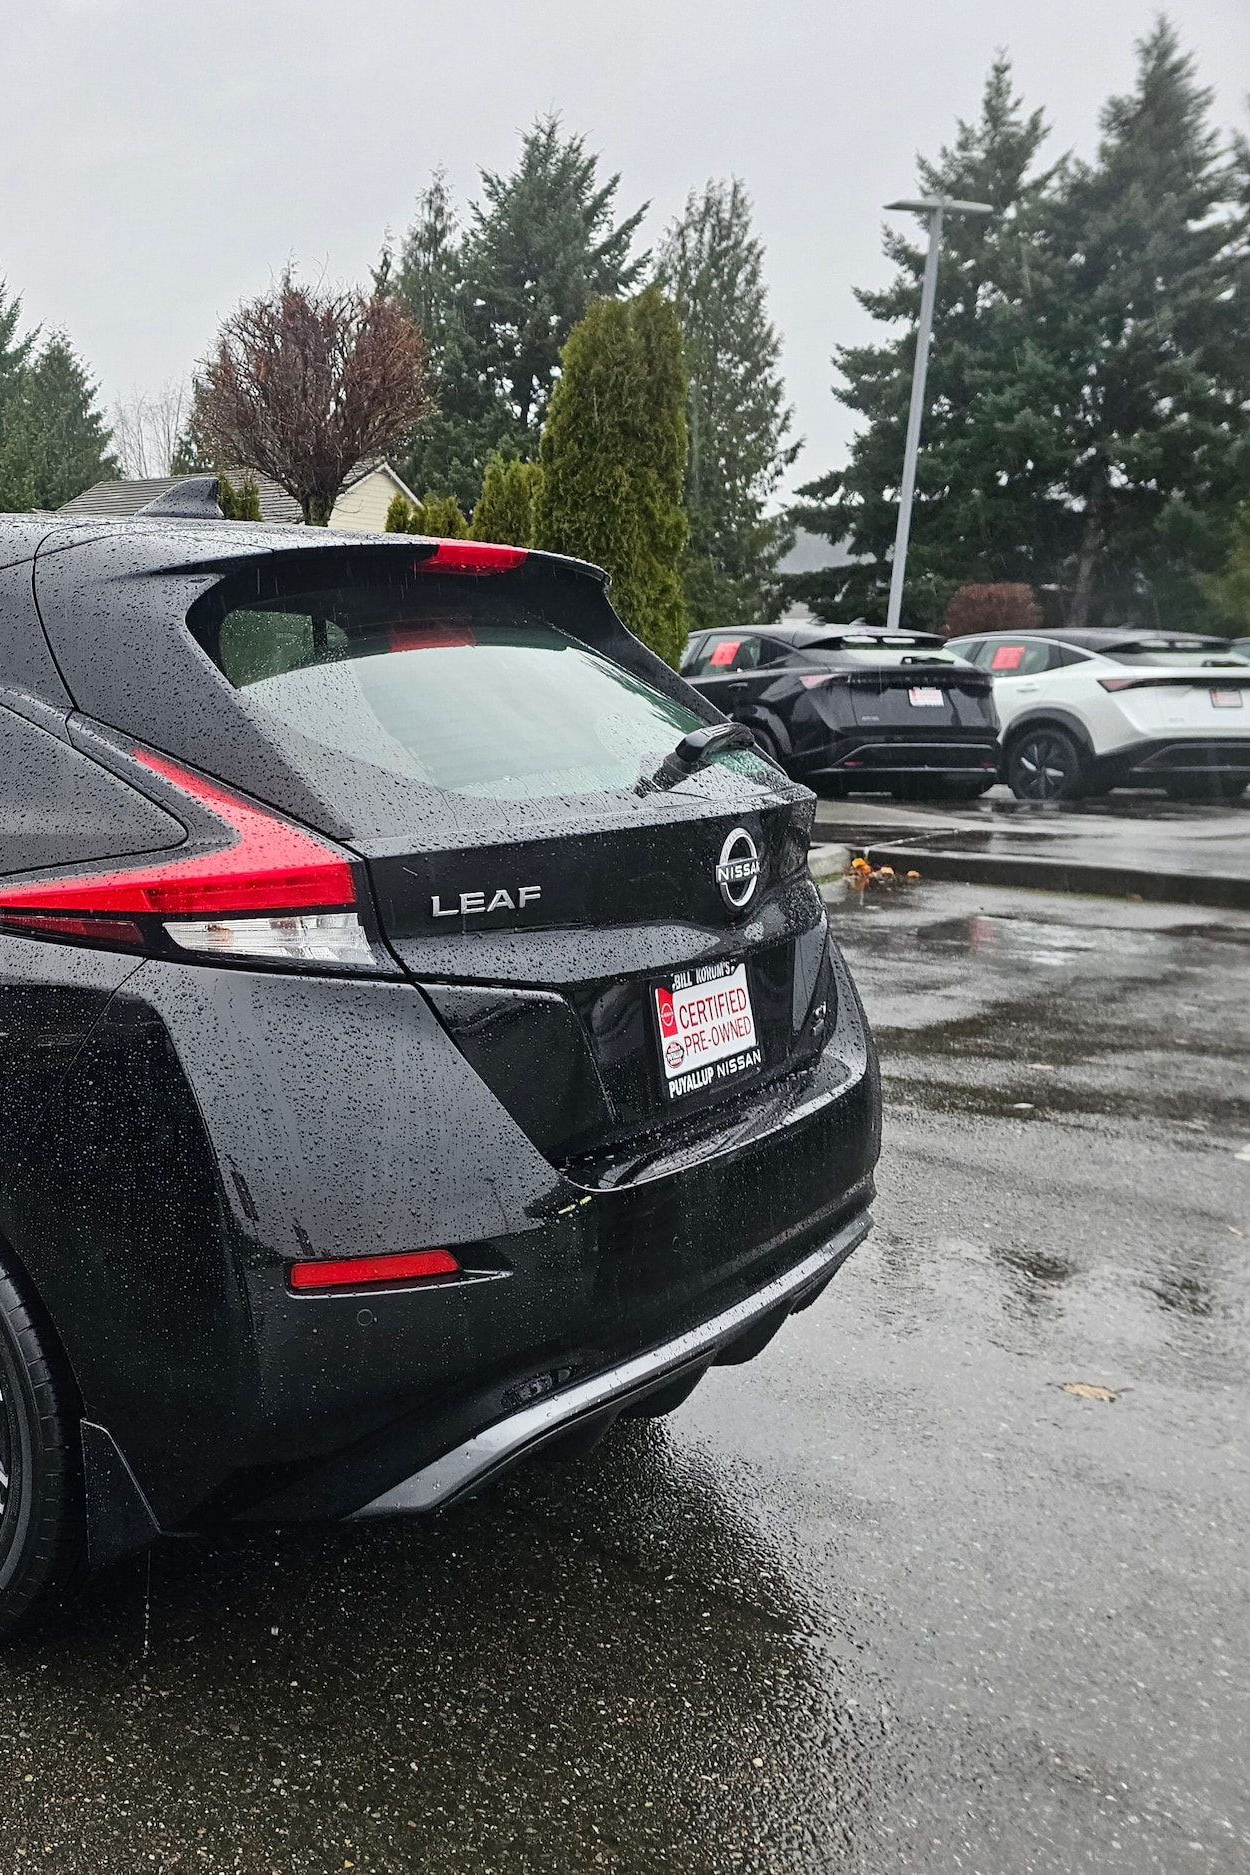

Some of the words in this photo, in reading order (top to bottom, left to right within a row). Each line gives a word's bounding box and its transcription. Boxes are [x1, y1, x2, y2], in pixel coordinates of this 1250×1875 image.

[430, 885, 542, 918] LEAF
[673, 972, 693, 990] BILL
[695, 961, 731, 984] KORUM'S
[679, 987, 747, 1030] CERTIFIED
[683, 1015, 752, 1057] PRE-OWNED
[668, 1066, 715, 1099] PUYALLUP
[716, 1048, 762, 1078] NISSAN
